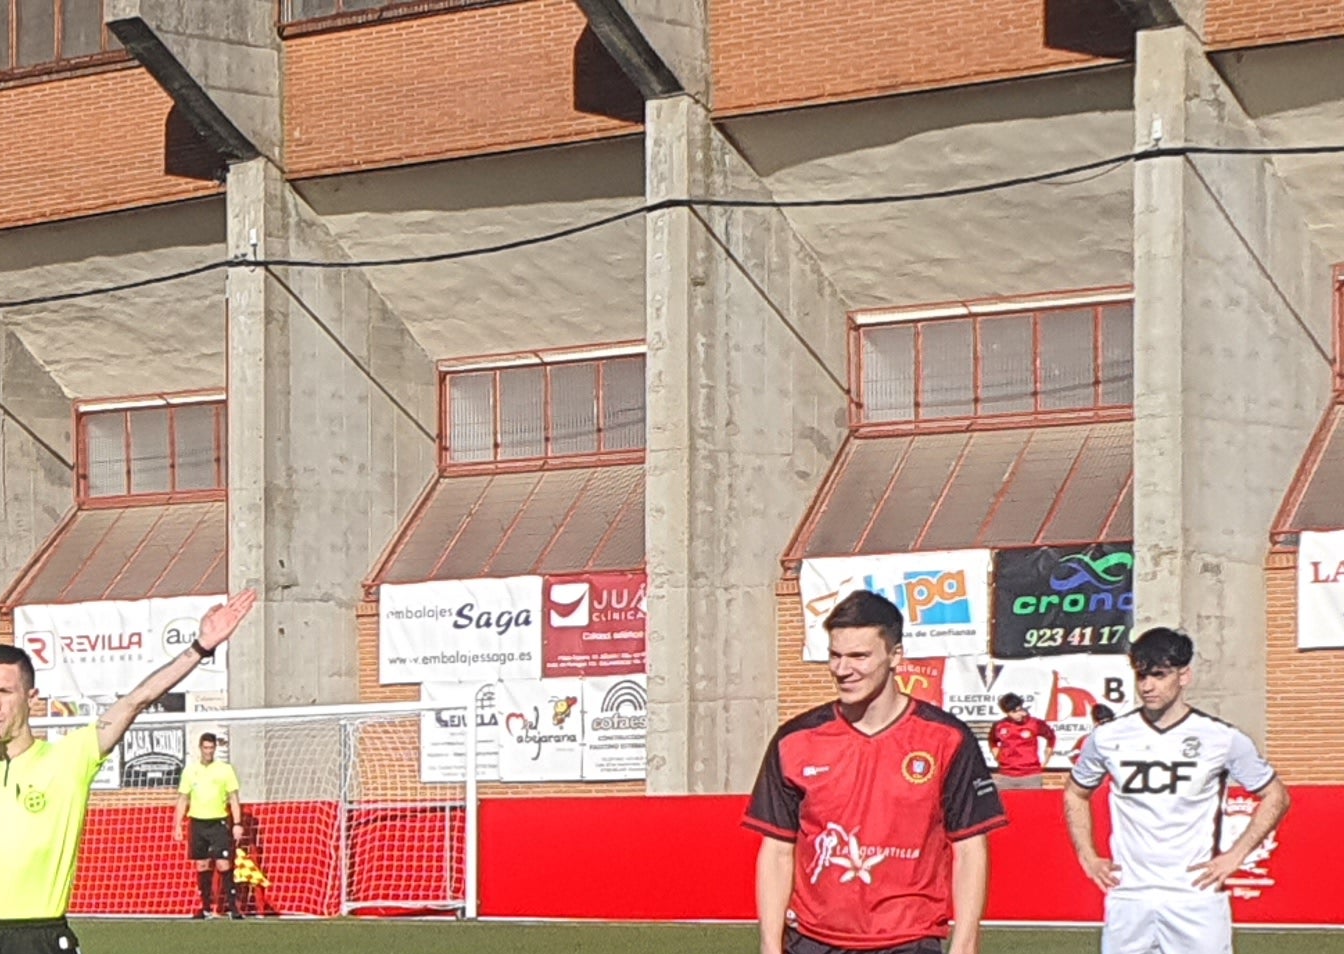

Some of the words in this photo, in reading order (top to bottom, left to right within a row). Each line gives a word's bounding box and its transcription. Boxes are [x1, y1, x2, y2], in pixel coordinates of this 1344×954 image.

[452, 603, 532, 635] Saga
[61, 632, 143, 653] REVILLA
[1024, 628, 1064, 647] 923
[1067, 626, 1093, 645] 41
[1098, 625, 1125, 645] 17
[1120, 761, 1198, 795] ZCF
